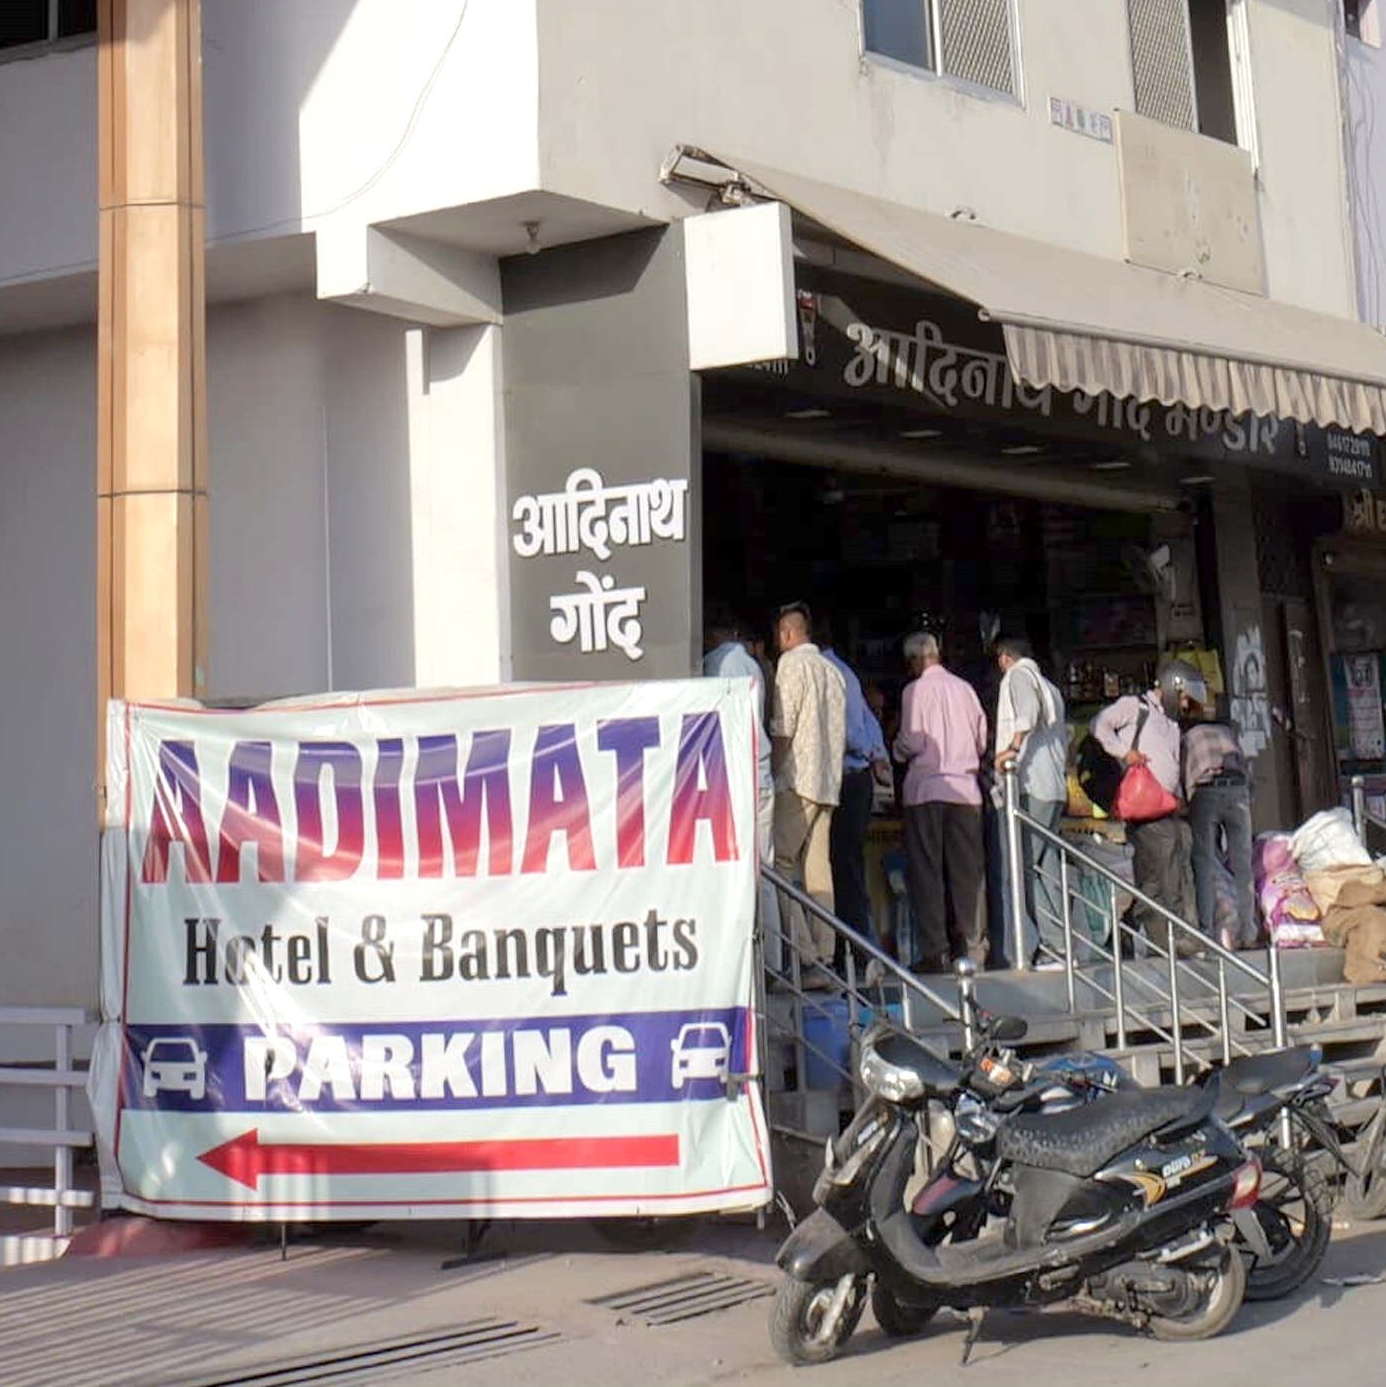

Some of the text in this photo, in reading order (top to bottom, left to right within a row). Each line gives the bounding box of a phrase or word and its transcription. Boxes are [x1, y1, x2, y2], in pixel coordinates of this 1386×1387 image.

[512, 468, 688, 561] आदिनाथ
[550, 570, 647, 661] गोंद
[141, 711, 740, 884] AADIMATA
[183, 909, 699, 995] Hotel & Banquets
[243, 1024, 637, 1102] PARKING
